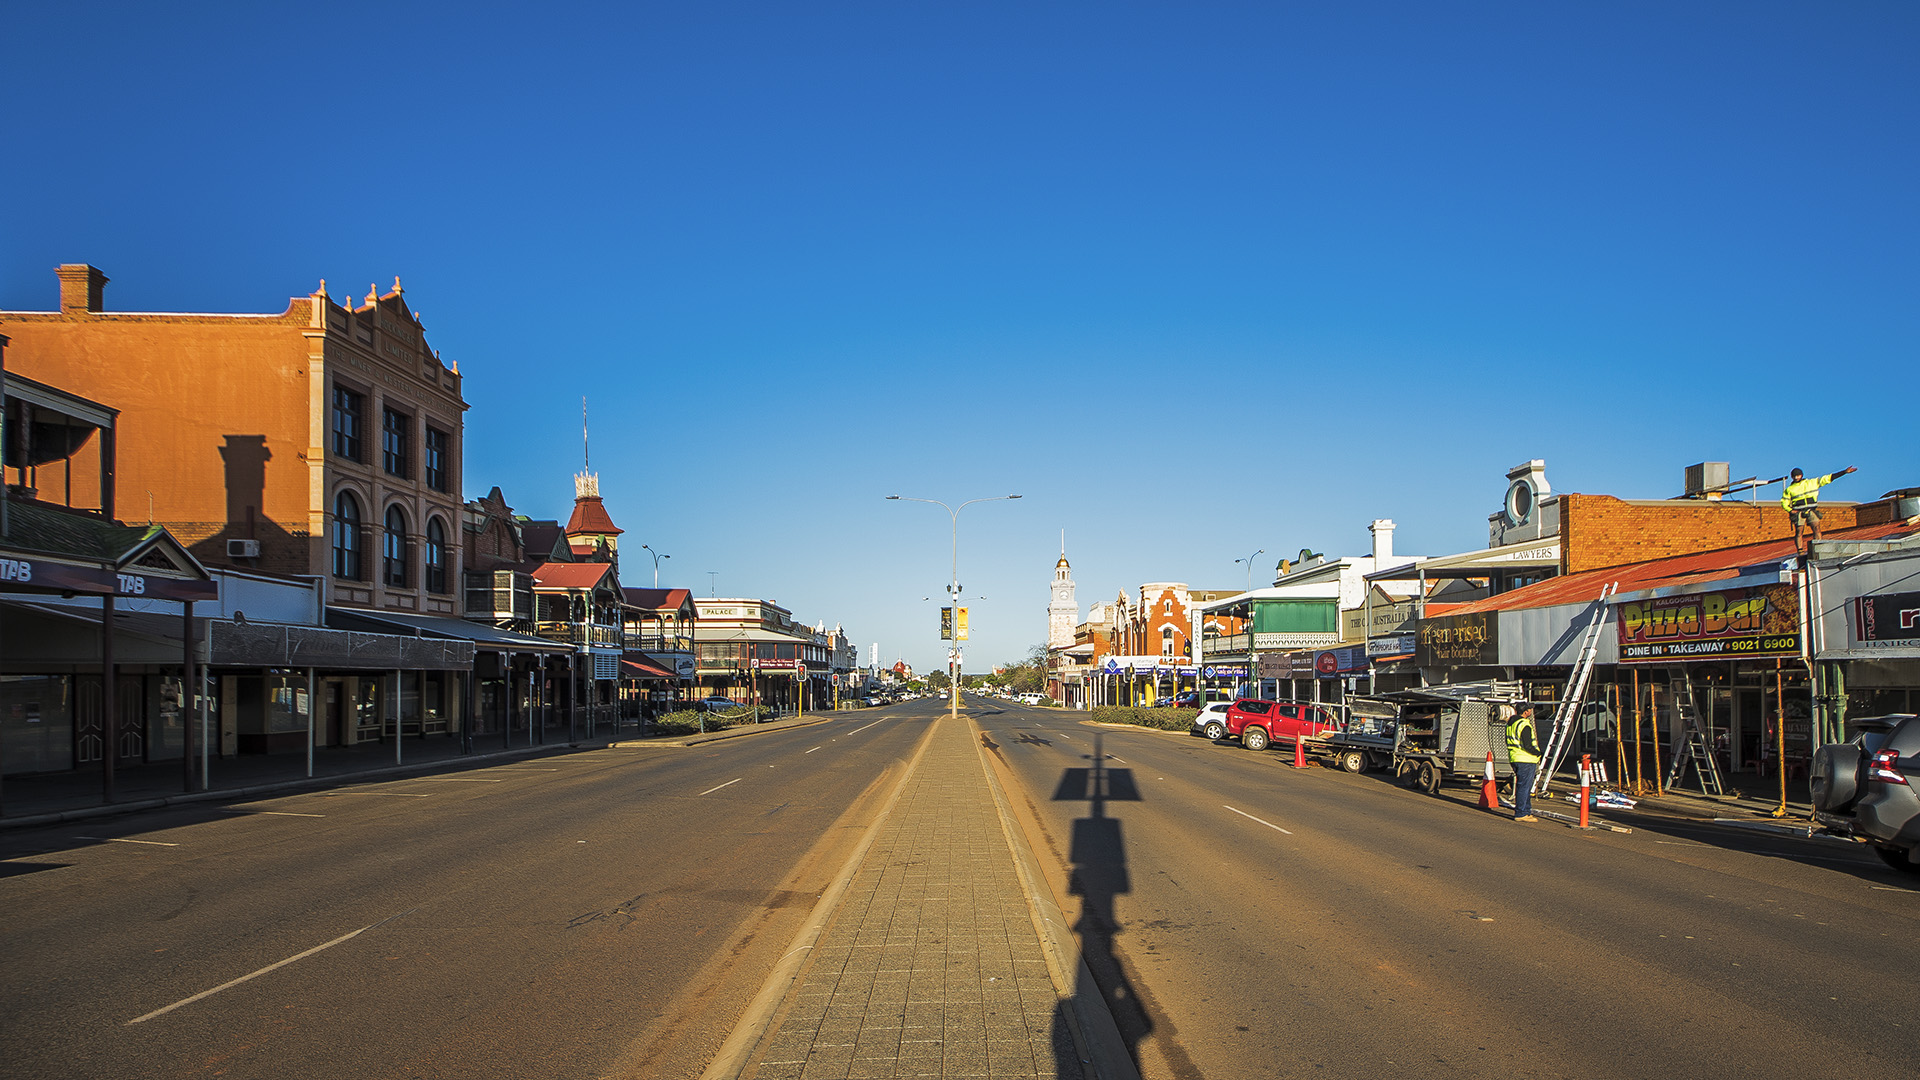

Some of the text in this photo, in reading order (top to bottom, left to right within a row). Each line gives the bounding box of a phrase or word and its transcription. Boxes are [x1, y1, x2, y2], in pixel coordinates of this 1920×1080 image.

[385, 340, 414, 365] LIMITED
[330, 346, 346, 361] THE
[350, 356, 372, 376] MINER
[384, 374, 413, 395] WESTERN
[1512, 547, 1553, 560] LAWYERS
[0, 558, 32, 582] TAB
[116, 573, 145, 595] TAB
[1655, 595, 1701, 606] KALGOORLIE
[1351, 618, 1361, 628] THE
[1373, 612, 1405, 626] AUSTRALIA
[1624, 594, 1769, 640] Pizza Bar
[1864, 599, 1876, 640] rust
[1627, 638, 1795, 657] DINE IN TAKEAWAY 9021 6900
